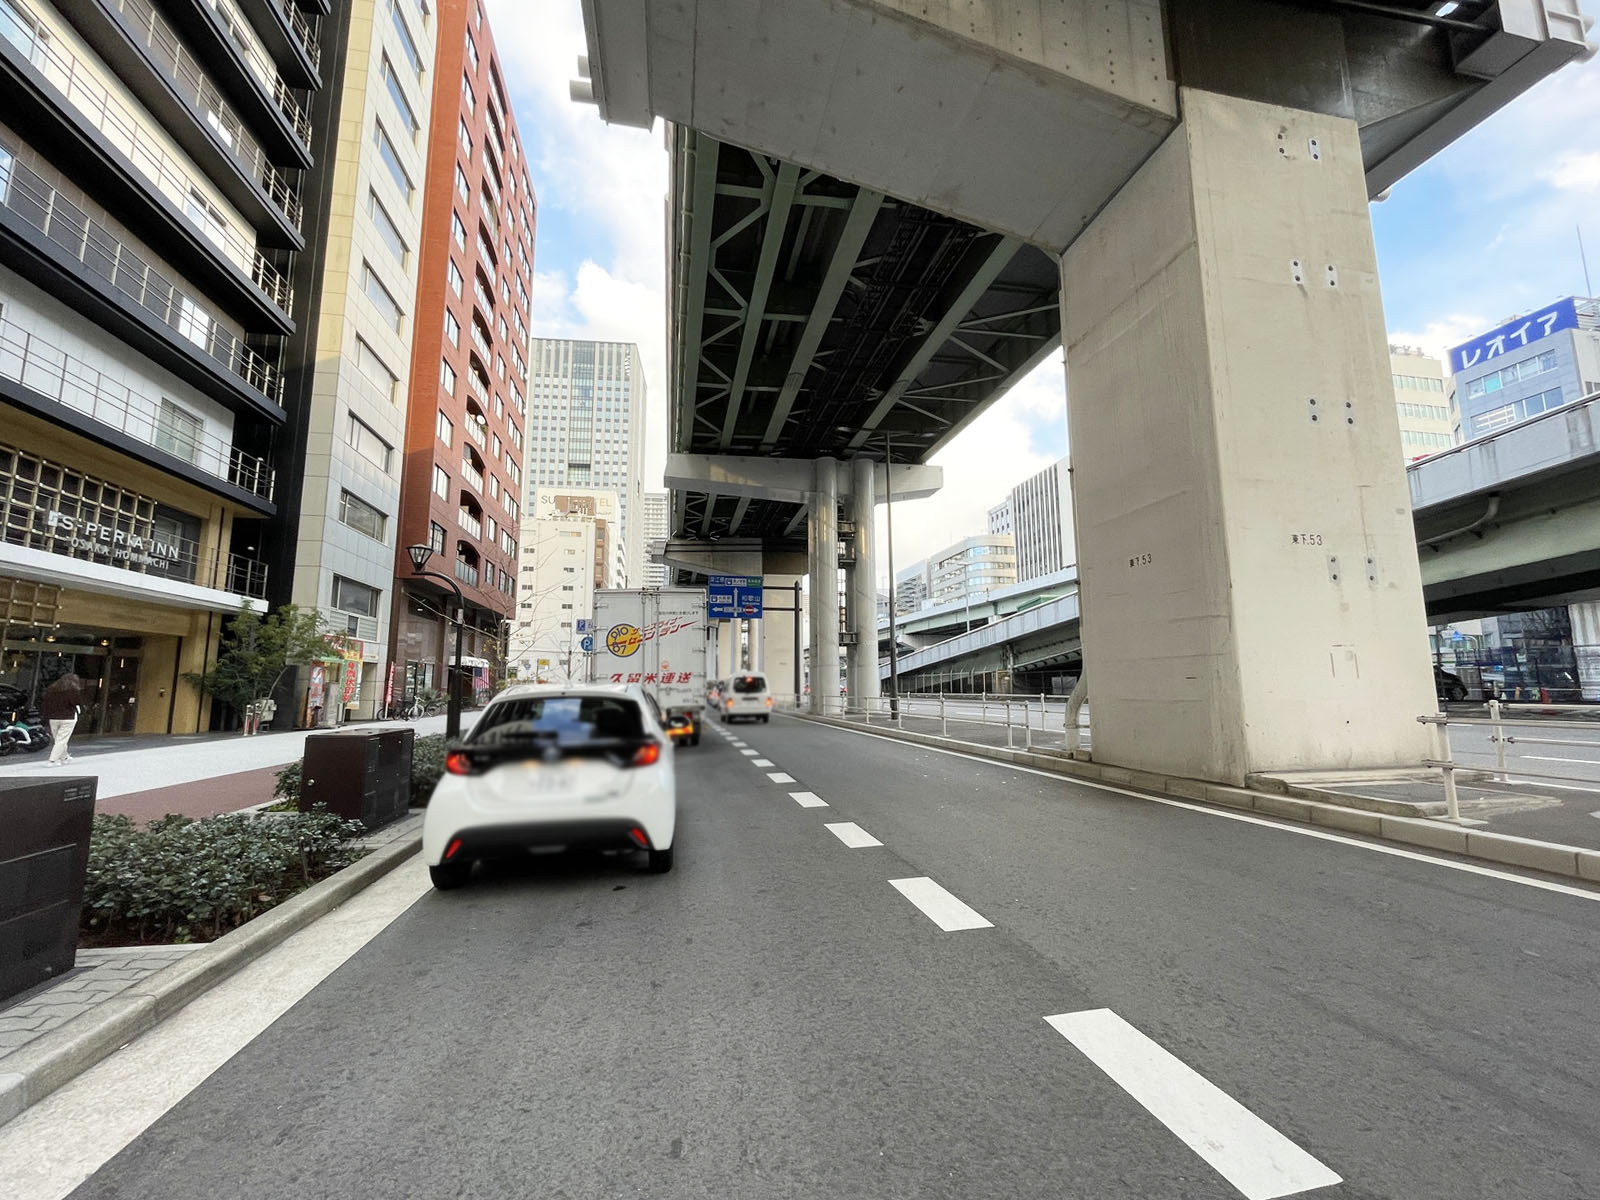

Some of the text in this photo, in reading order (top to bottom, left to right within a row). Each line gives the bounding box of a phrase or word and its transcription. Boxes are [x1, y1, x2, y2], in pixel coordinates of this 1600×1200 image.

[1461, 311, 1558, 369] レオイア
[71, 537, 169, 570] OSAKA HOMMACHI
[151, 541, 179, 559] INN
[610, 671, 693, 685] 久留米運送
